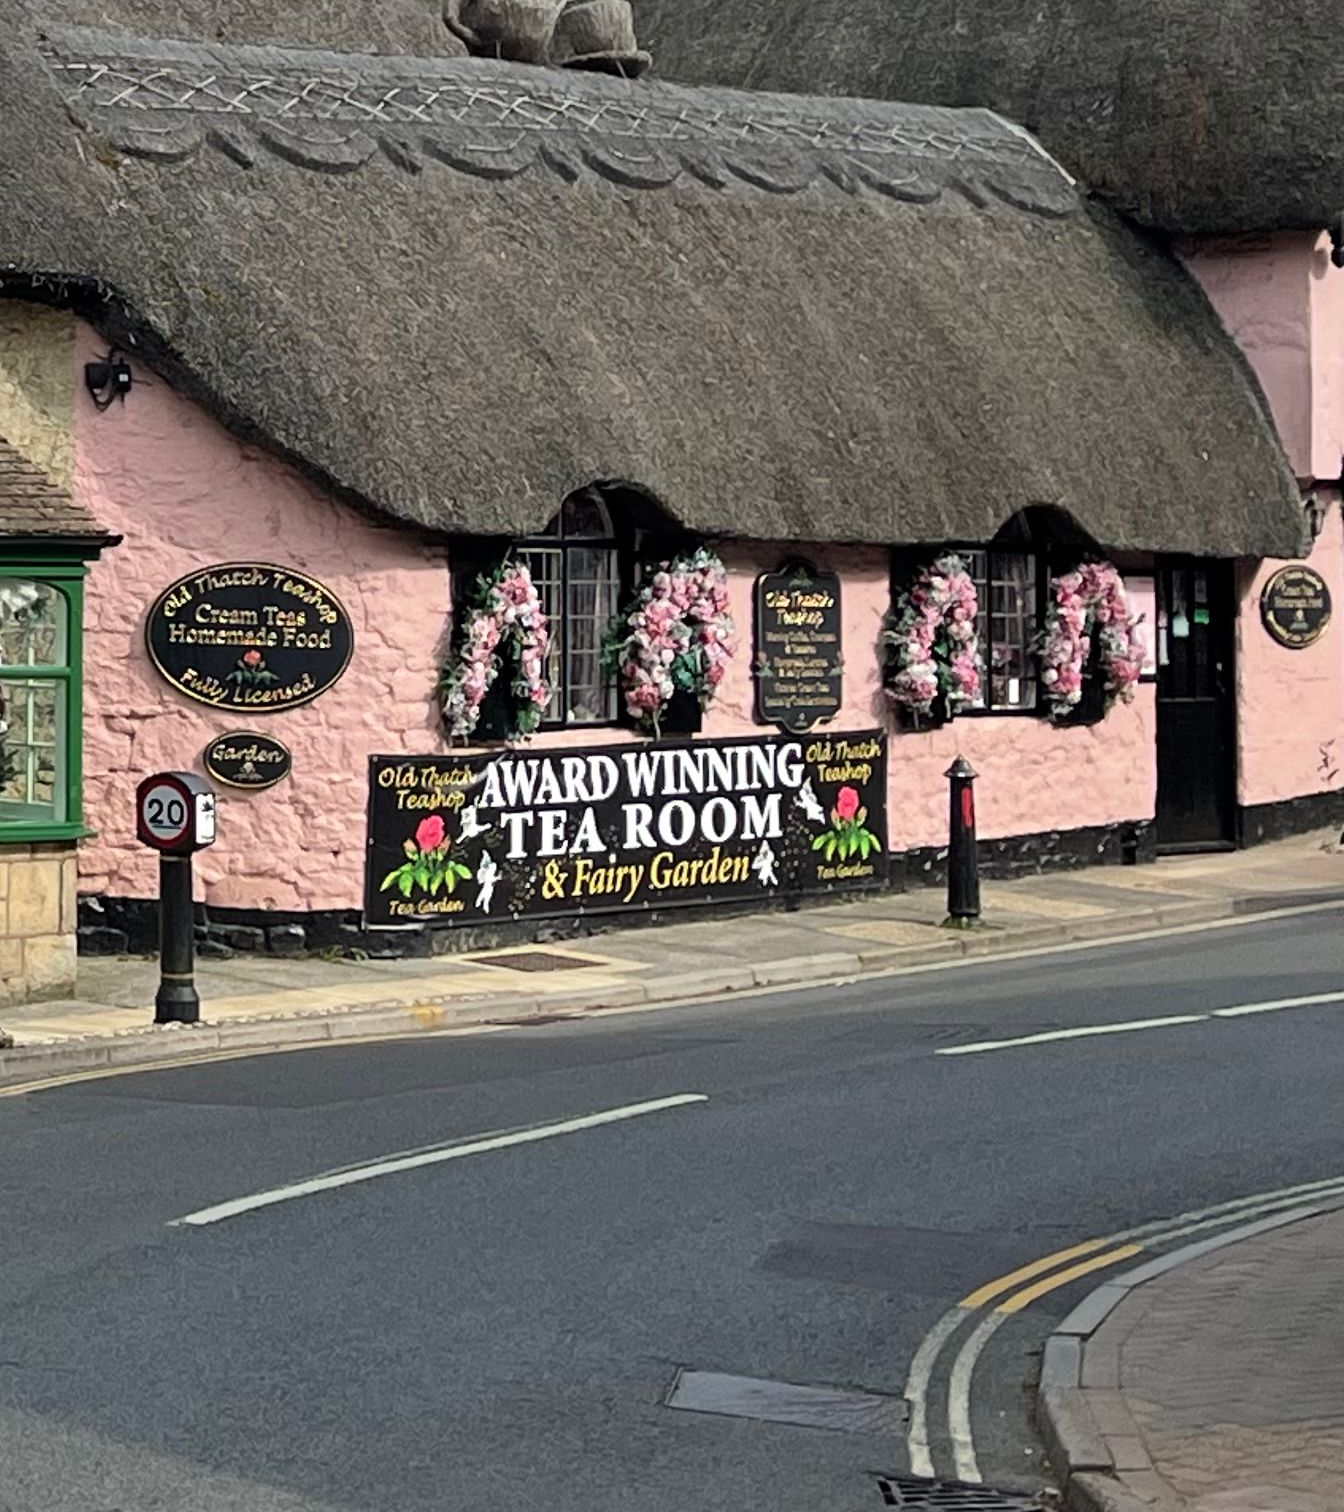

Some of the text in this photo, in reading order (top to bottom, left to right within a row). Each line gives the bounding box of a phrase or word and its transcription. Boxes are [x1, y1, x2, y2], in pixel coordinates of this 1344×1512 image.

[164, 568, 338, 624] Old Thatch Teashop
[195, 603, 307, 627] Cream Teas
[169, 623, 331, 649] Homemade Food
[180, 668, 317, 704] Fully Licensed
[212, 744, 284, 763] Garden
[806, 738, 882, 763] Old Thatch
[378, 764, 478, 787] Old Thatch
[479, 743, 805, 809] AWARD WINNING
[818, 764, 872, 785] Teashop
[148, 799, 184, 825] 20
[396, 789, 466, 814] Teashop
[501, 793, 783, 859] TEA ROOM
[542, 846, 750, 903] & Fairy Garden
[389, 896, 465, 916] Tea Garden
